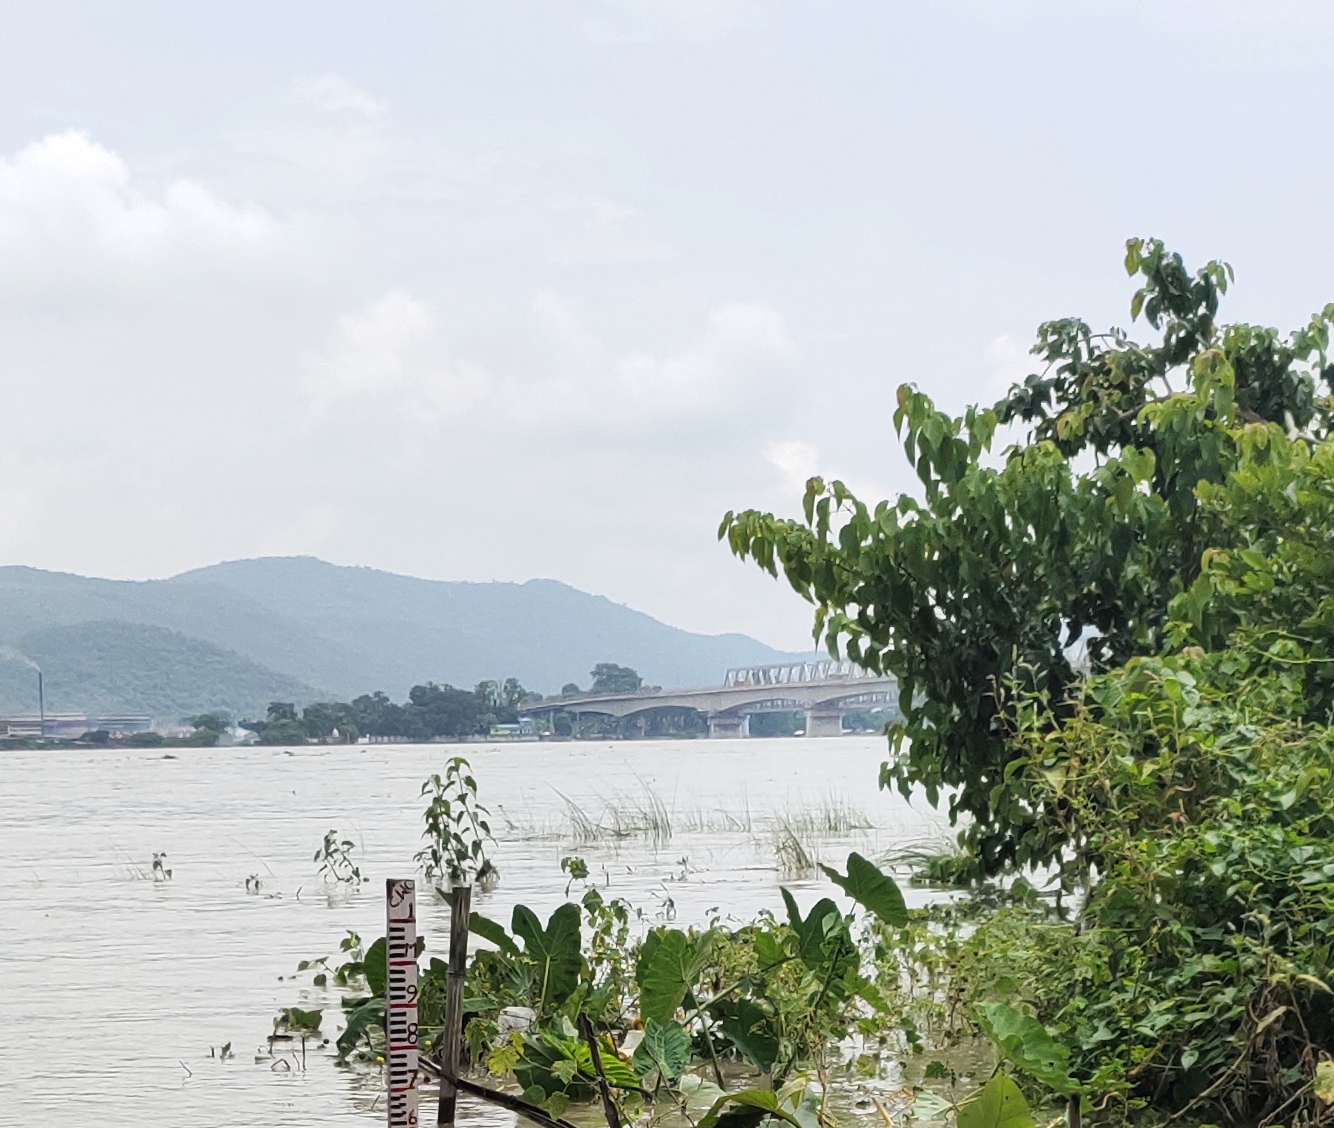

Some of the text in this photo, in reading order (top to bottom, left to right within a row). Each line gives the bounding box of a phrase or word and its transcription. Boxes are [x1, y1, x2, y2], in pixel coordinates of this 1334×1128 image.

[405, 943, 417, 959] M
[406, 984, 418, 1004] 9
[407, 1022, 418, 1045] 8
[407, 1069, 418, 1090] 7
[408, 1109, 418, 1125] 6
